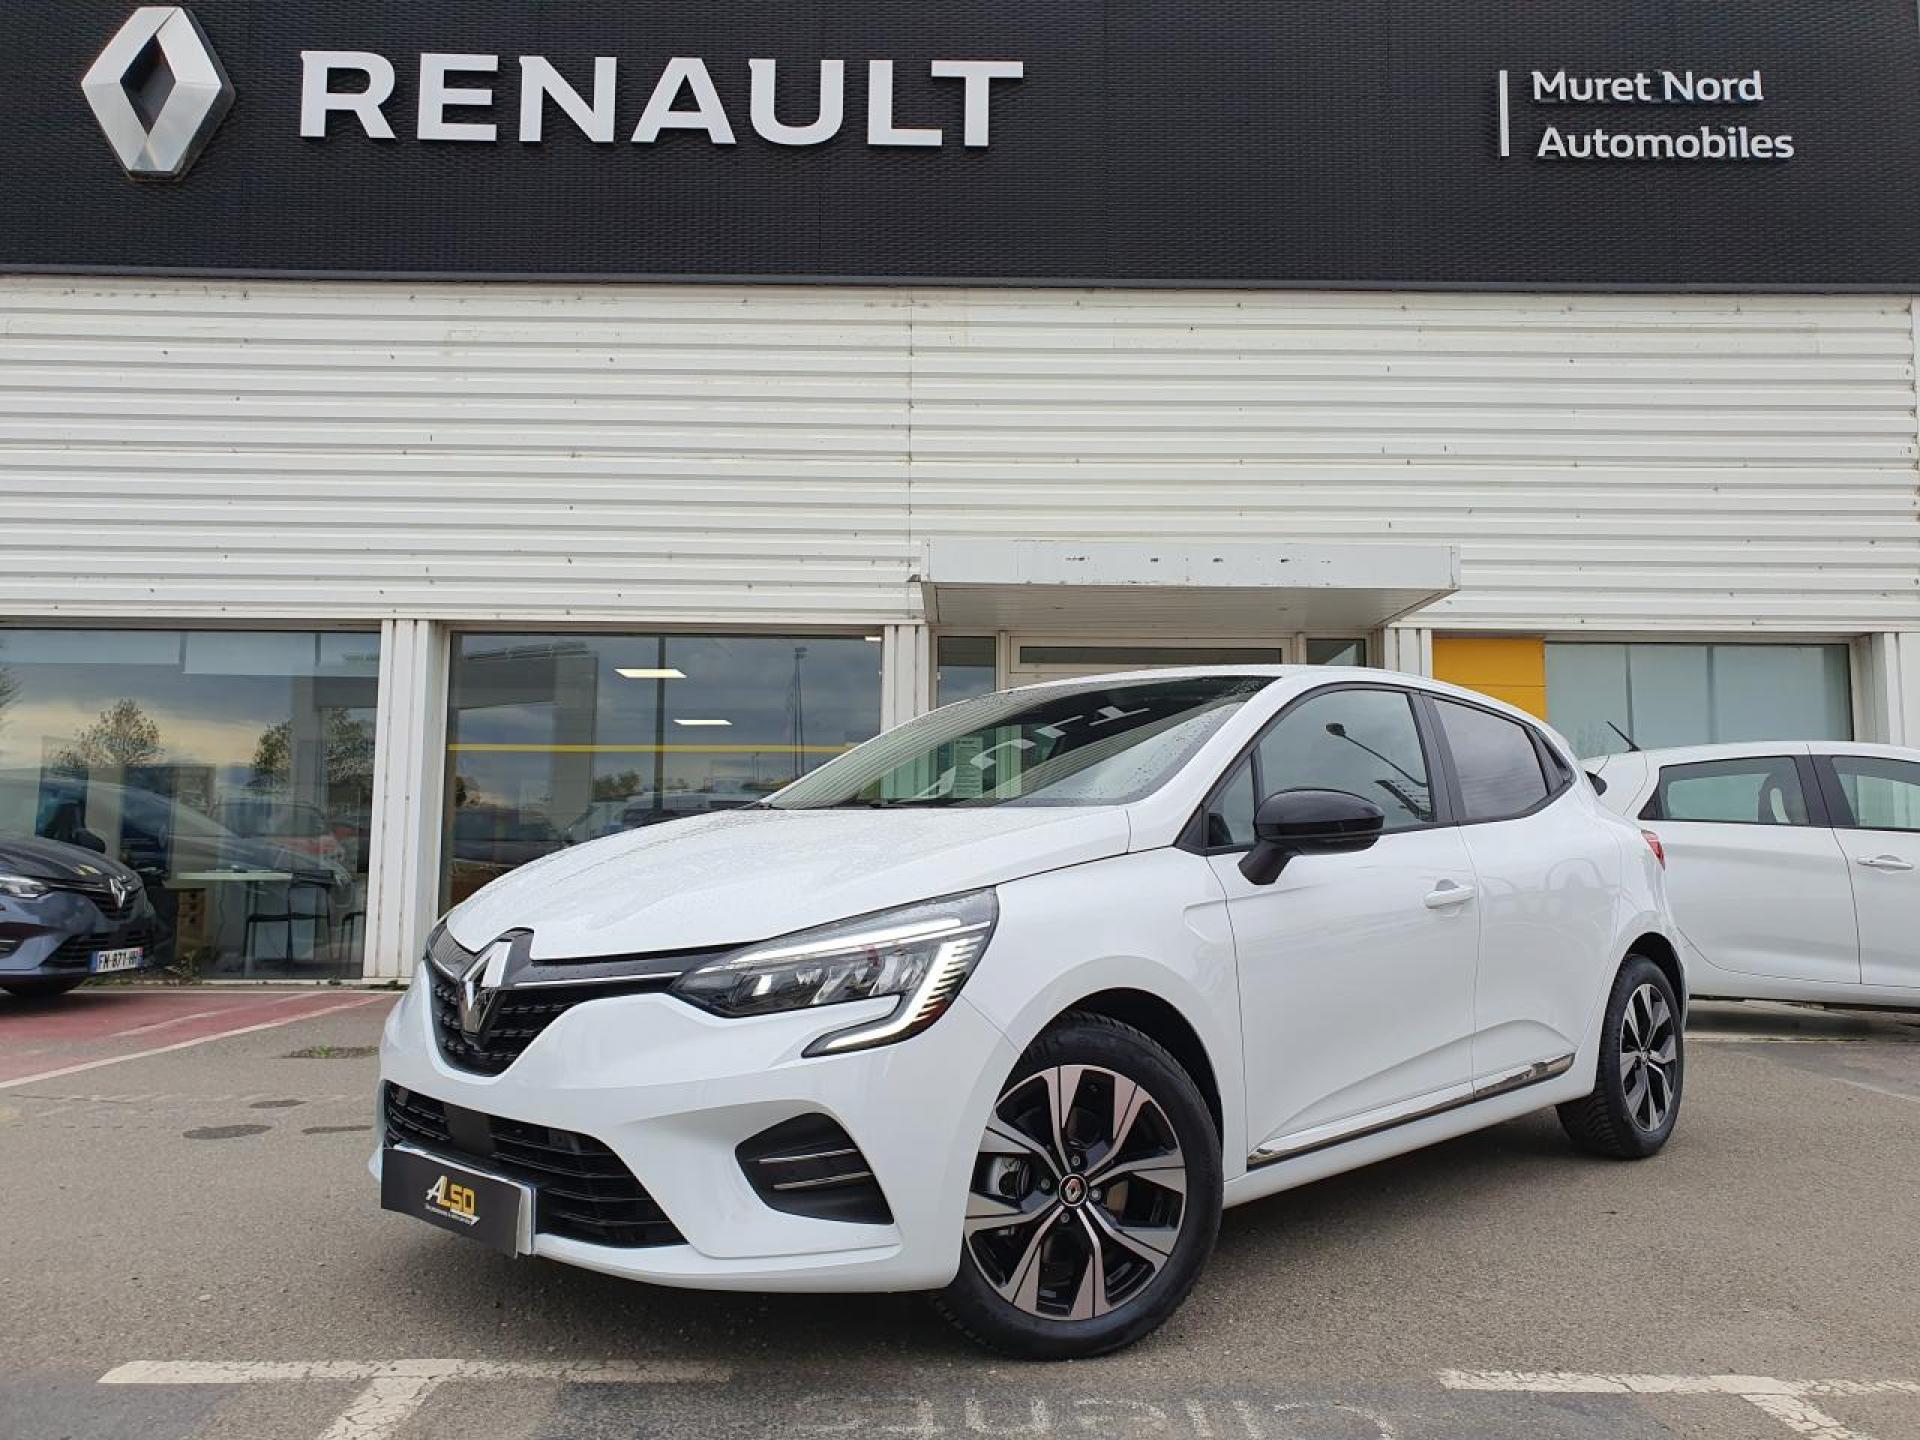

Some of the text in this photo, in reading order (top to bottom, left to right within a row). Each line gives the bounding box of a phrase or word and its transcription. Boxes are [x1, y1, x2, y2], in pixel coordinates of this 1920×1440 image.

[299, 50, 1024, 147] RENAULT
[1531, 70, 1765, 101] Muret Nord
[1537, 125, 1795, 159] Automobiles
